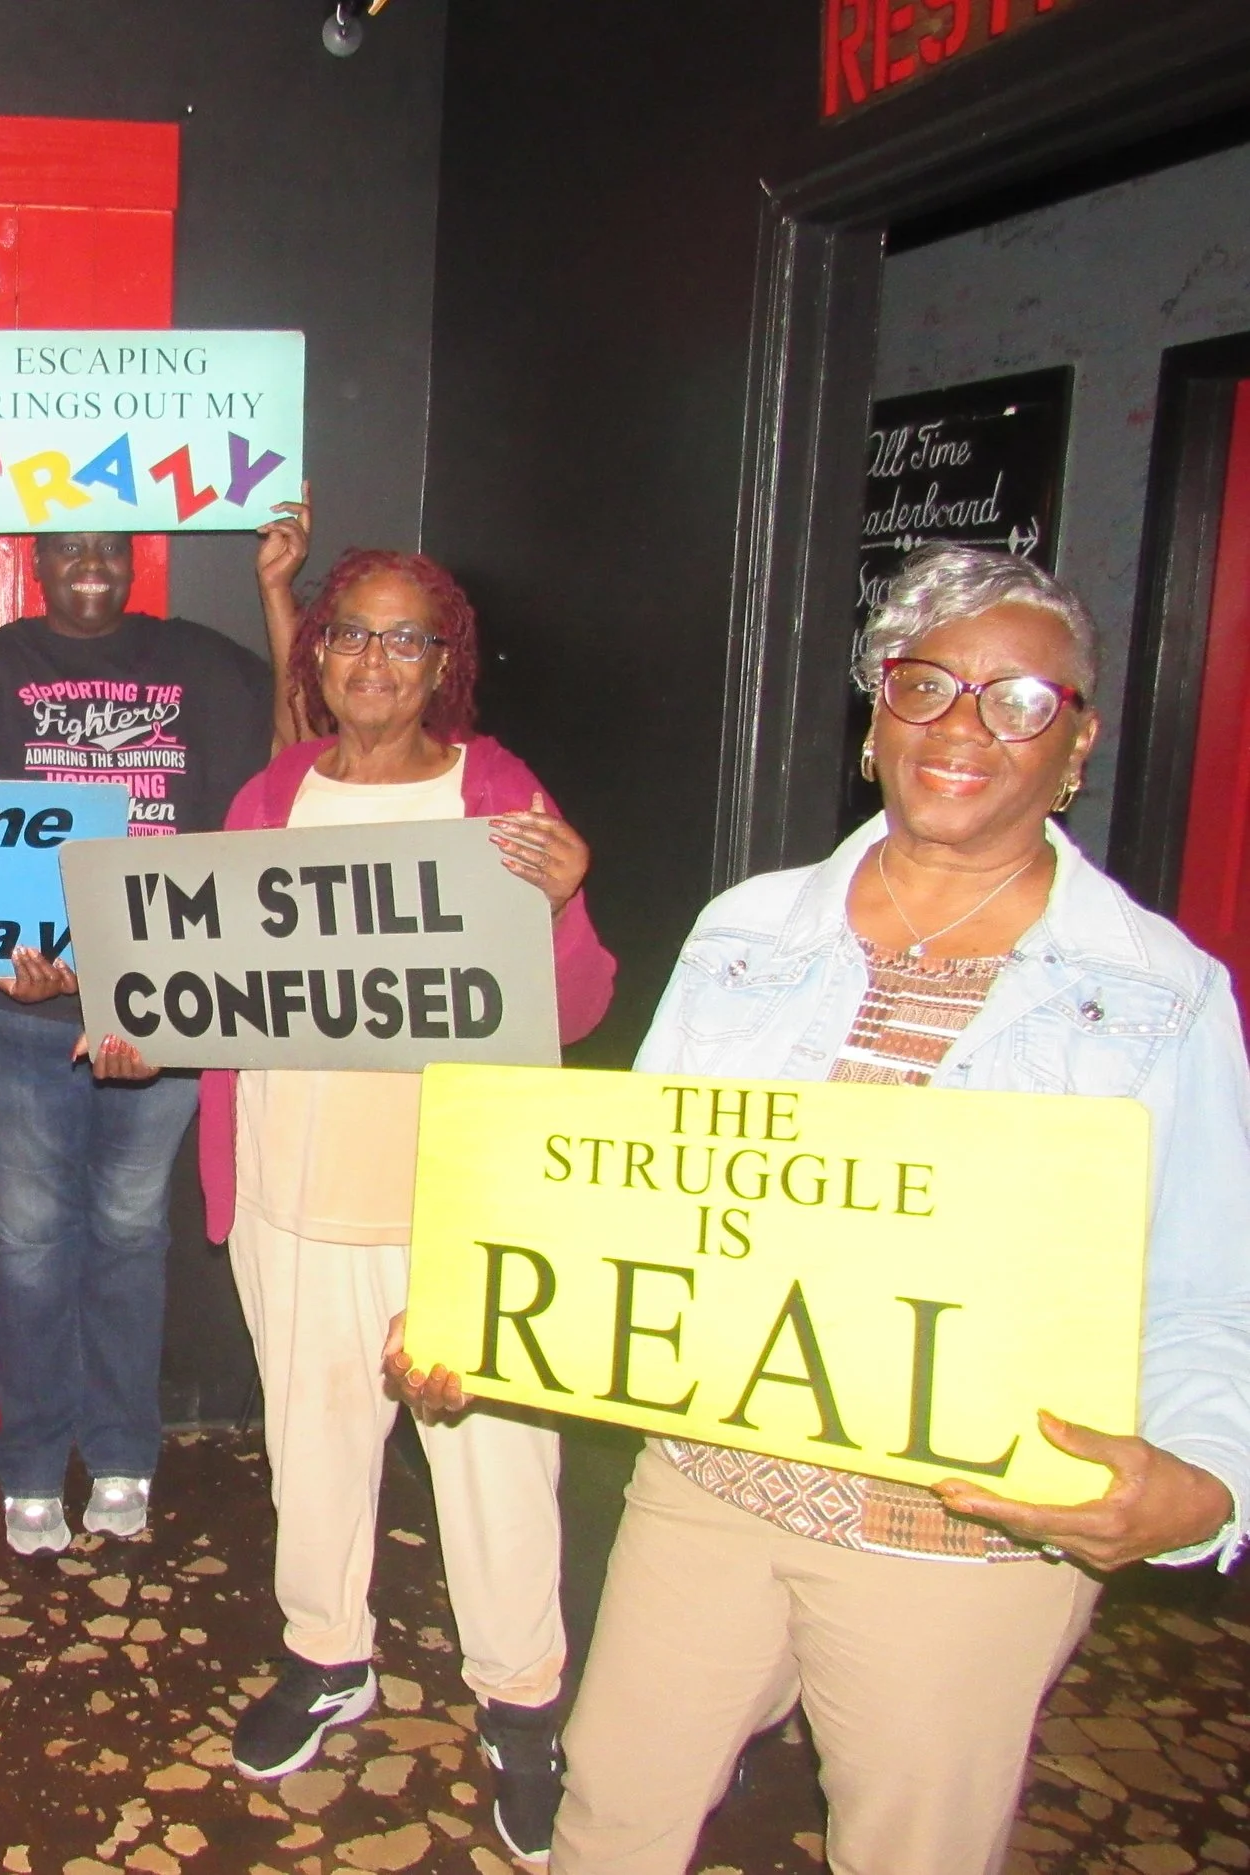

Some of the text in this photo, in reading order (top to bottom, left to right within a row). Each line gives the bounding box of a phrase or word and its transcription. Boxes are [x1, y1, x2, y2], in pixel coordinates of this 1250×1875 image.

[16, 347, 208, 375] ESCAPING
[114, 391, 192, 419] OUT
[205, 391, 265, 419] MY
[910, 420, 973, 470] Time
[863, 471, 1003, 536] aderboard
[146, 685, 183, 704] THE
[34, 699, 180, 746] Fighters
[25, 748, 185, 769] ADMIRING THE SURVIVORS
[127, 798, 176, 821] ken
[124, 860, 464, 941] I'M STILL
[113, 966, 503, 1039] CONFUSED
[661, 1085, 801, 1143] THE
[543, 1134, 936, 1218] STRUGGLE
[696, 1205, 752, 1260] IS
[466, 1240, 1021, 1478] REAL
